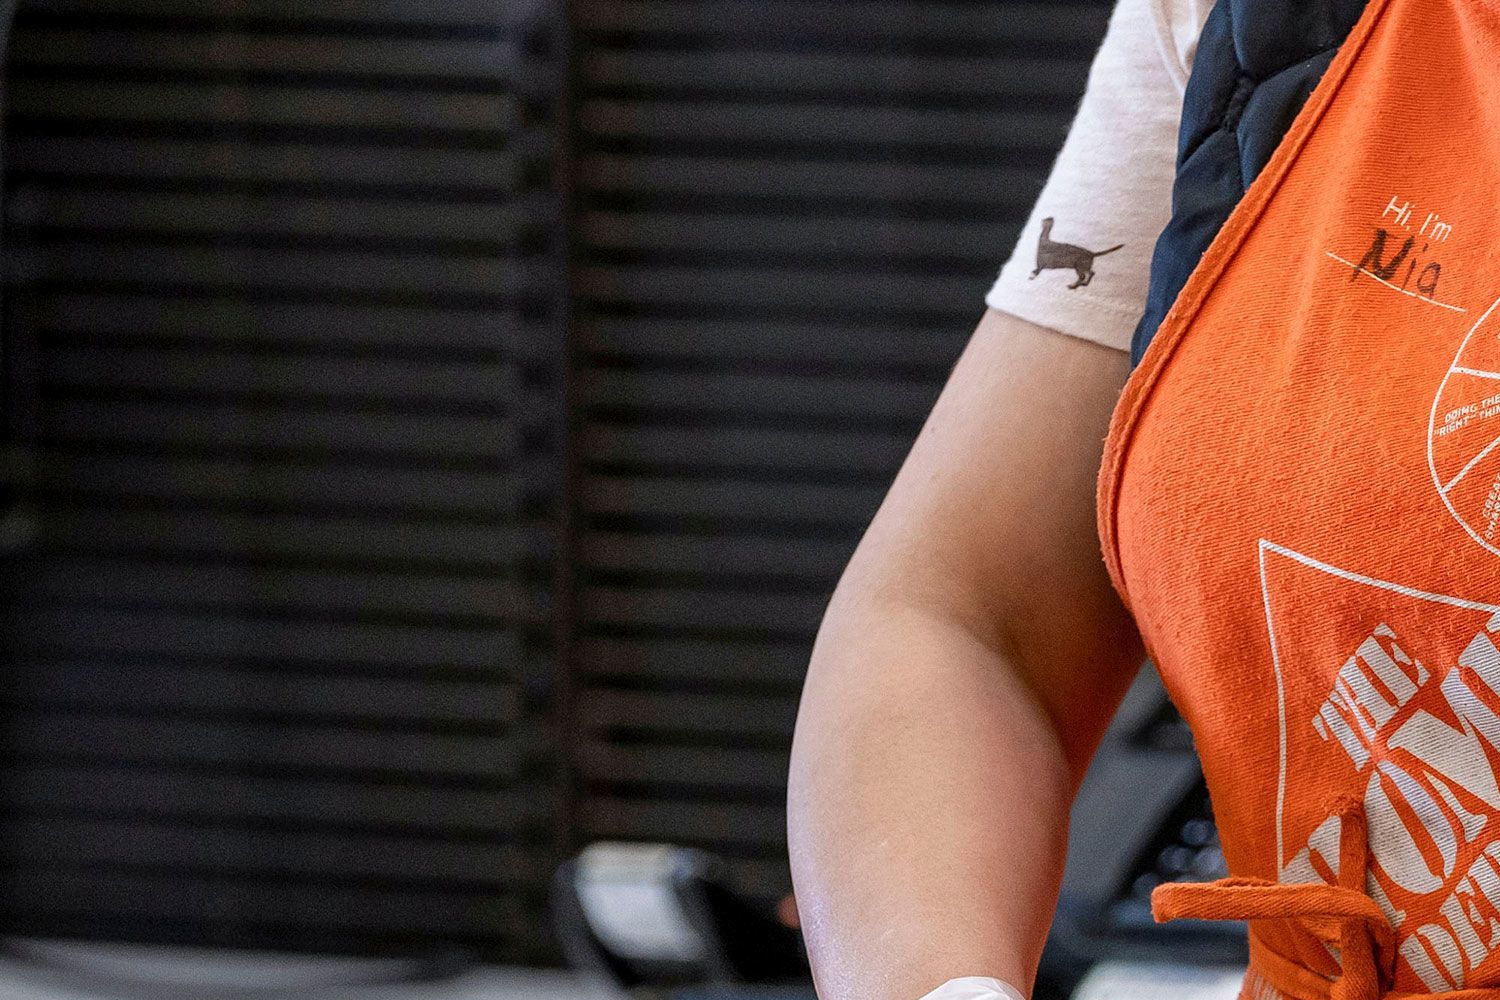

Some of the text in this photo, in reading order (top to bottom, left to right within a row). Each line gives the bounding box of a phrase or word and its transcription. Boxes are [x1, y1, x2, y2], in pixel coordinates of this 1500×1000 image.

[1382, 196, 1452, 242] Hi, I'm
[1445, 394, 1500, 424] DOING THE
[1311, 622, 1432, 772] THE
